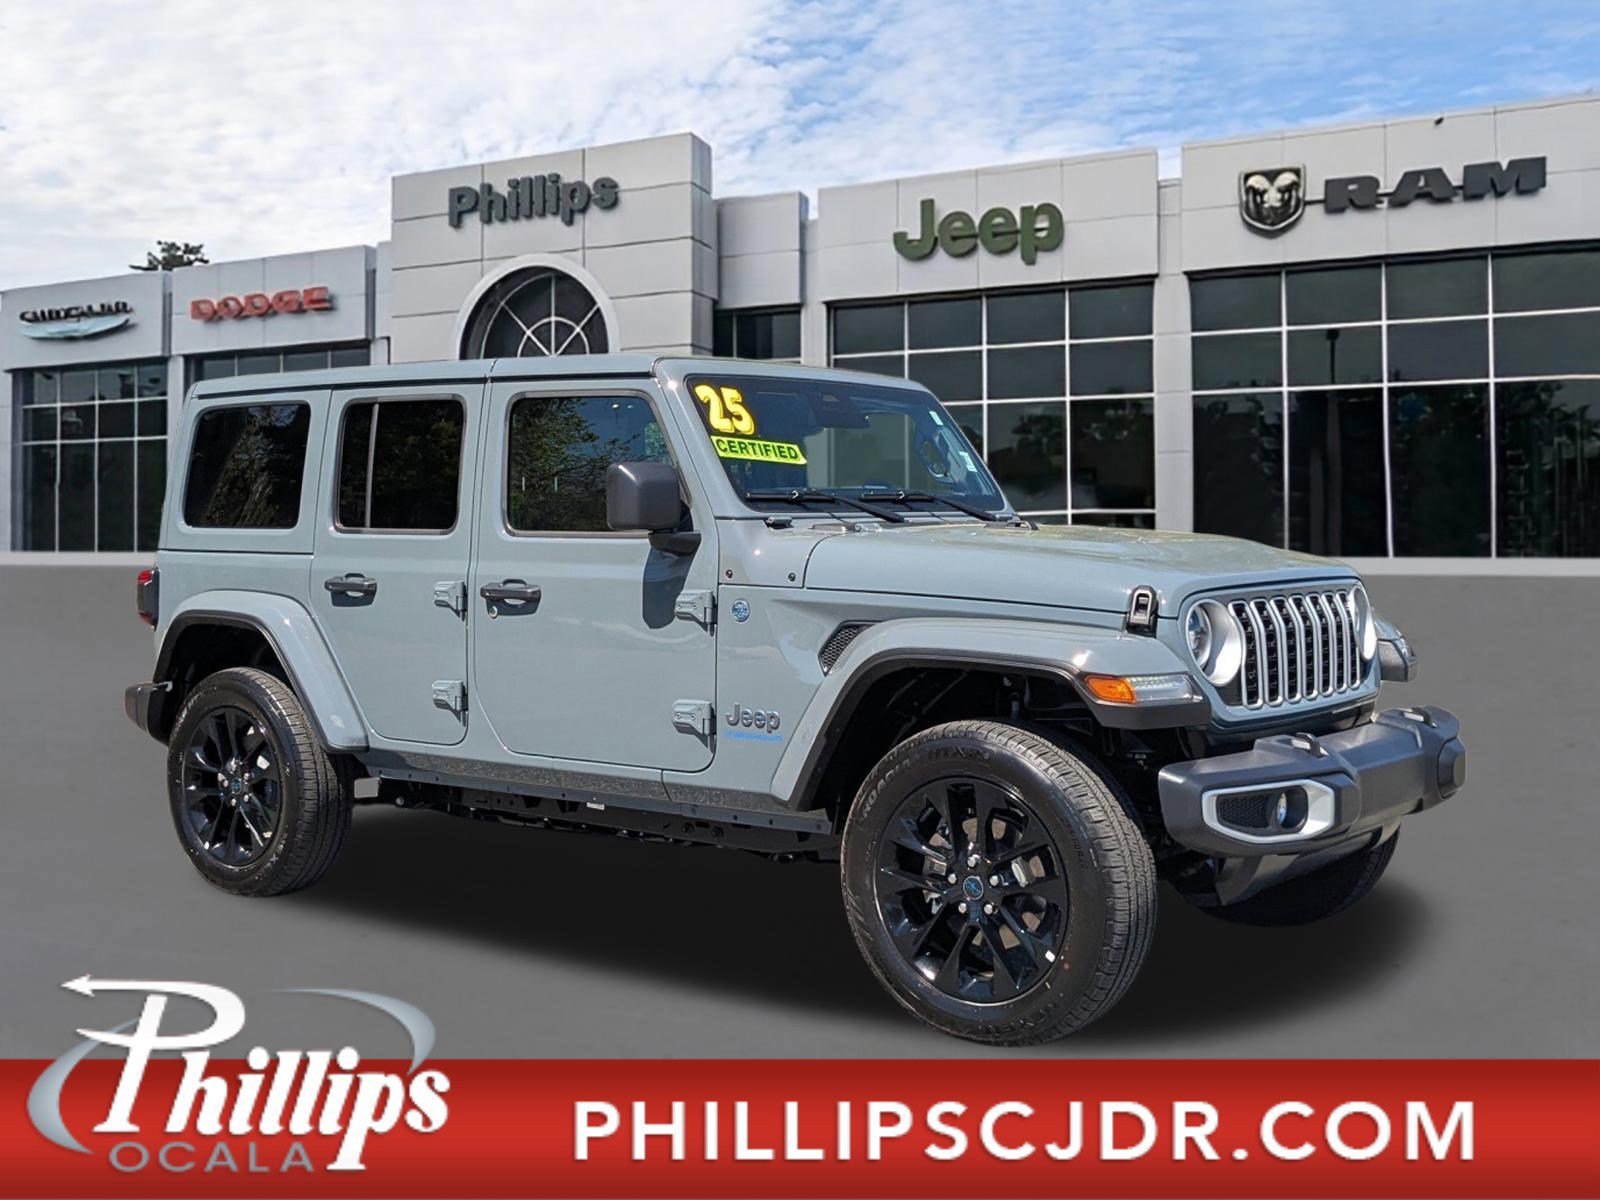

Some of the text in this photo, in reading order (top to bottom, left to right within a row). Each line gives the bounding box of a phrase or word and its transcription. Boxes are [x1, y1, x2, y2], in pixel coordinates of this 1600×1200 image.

[448, 172, 620, 230] Phillips
[1324, 156, 1547, 214] RAM
[893, 198, 1064, 266] Jeep
[190, 286, 330, 322] DODGE
[694, 384, 755, 436] 25
[715, 438, 799, 459] CERTIFIED
[725, 702, 781, 734] Jeep
